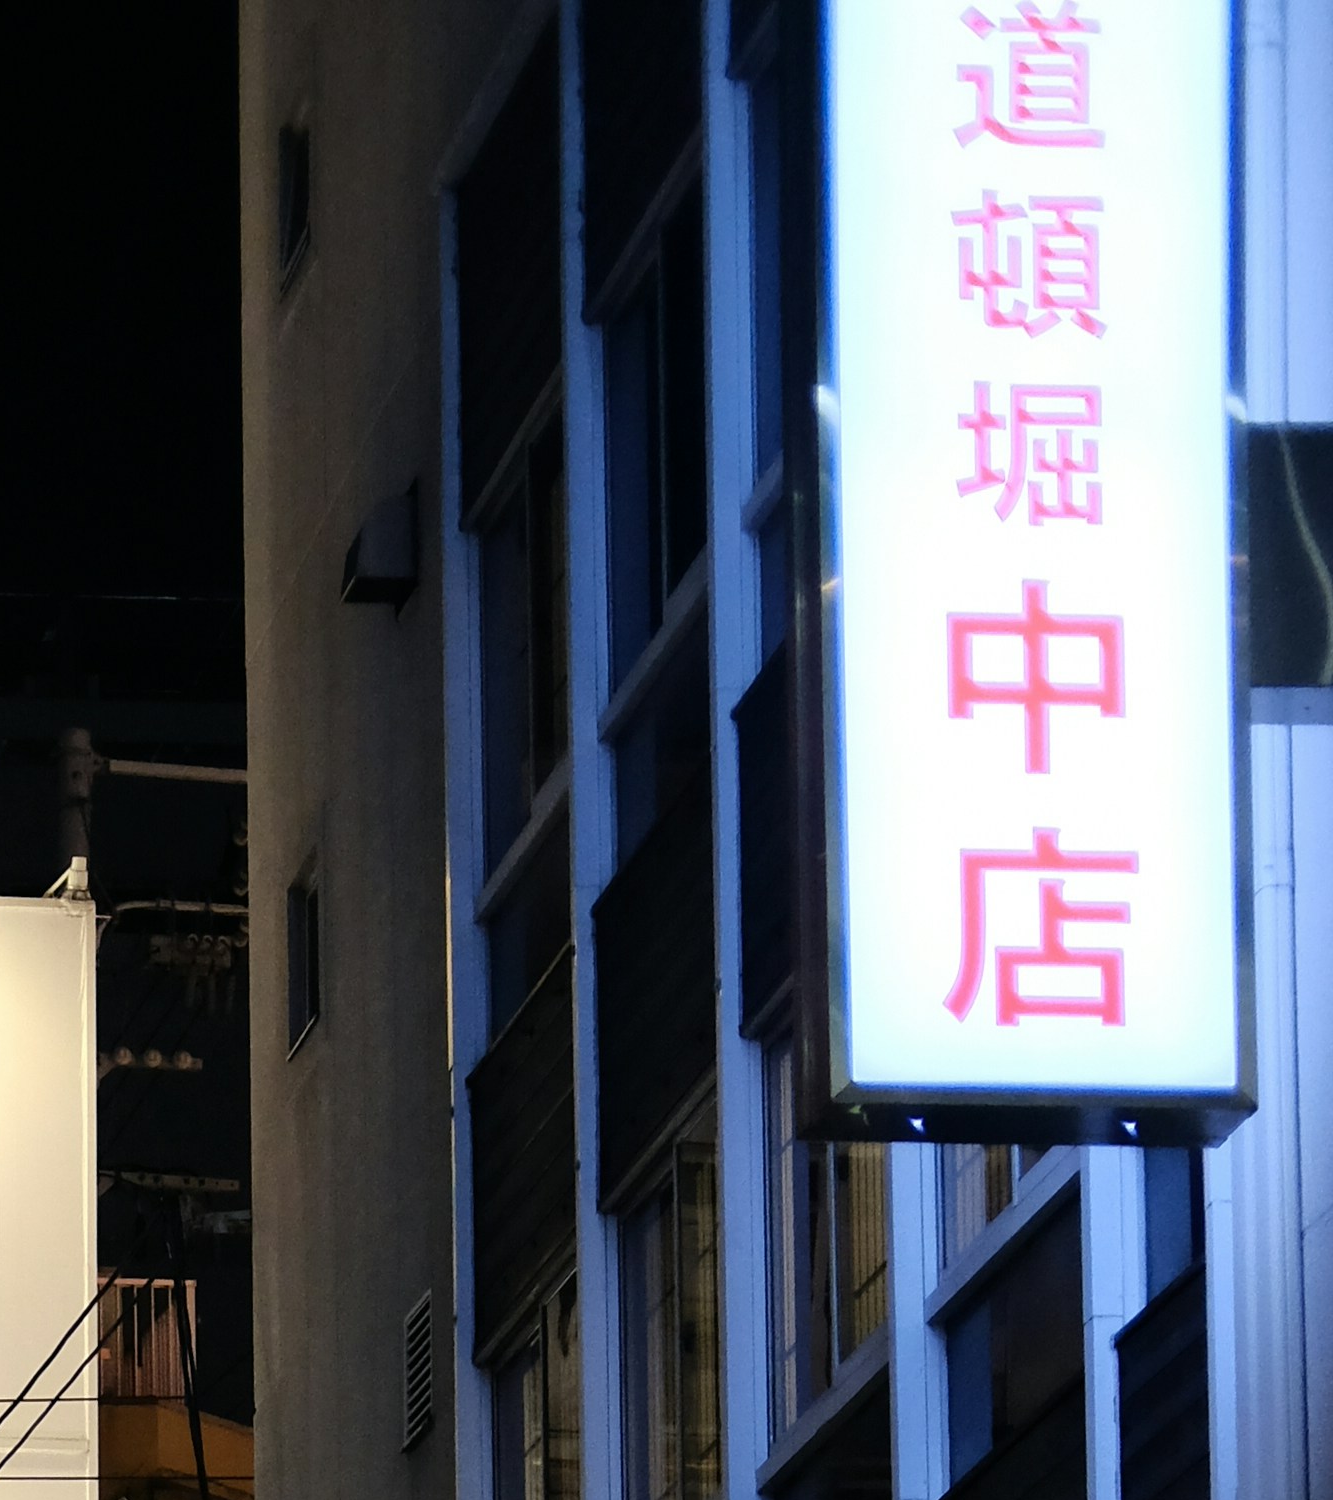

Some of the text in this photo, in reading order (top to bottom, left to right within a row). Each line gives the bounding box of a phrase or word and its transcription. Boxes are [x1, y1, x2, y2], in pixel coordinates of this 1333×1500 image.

[942, 1, 1140, 1028] 道頓堀中店
